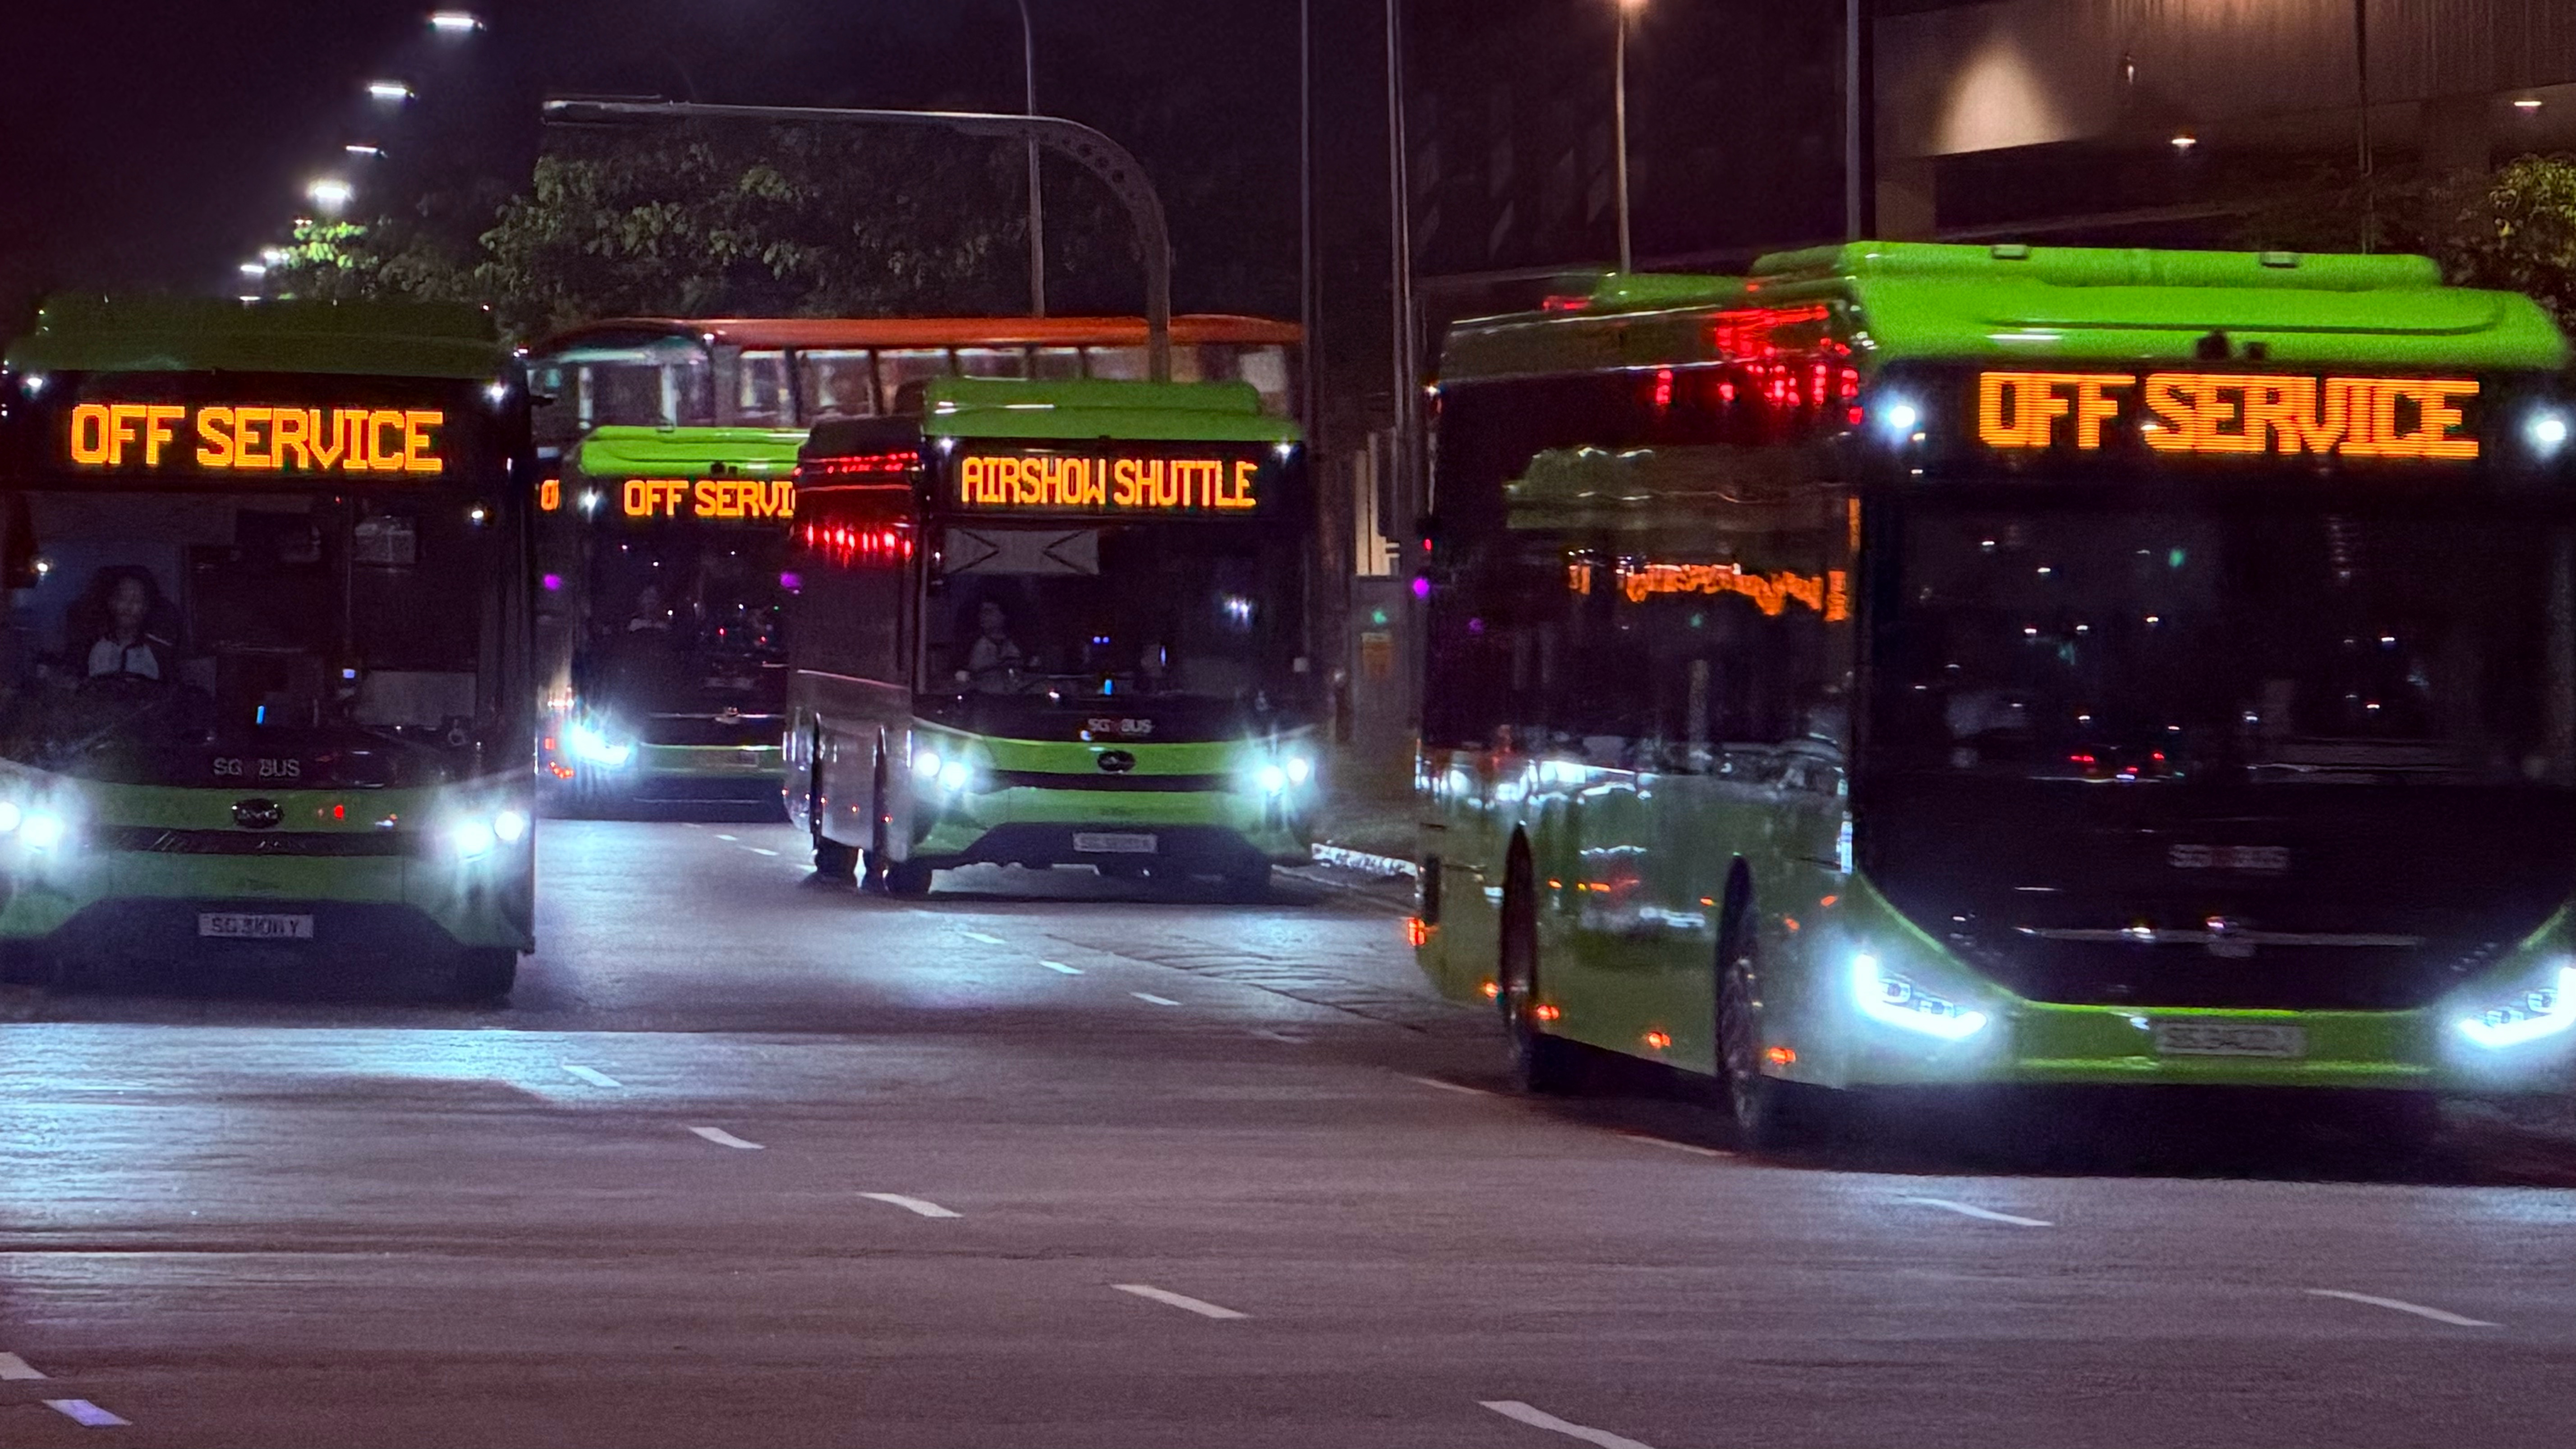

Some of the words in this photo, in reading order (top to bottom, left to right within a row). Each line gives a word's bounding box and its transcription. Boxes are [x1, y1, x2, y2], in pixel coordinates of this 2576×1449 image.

[70, 404, 185, 465] OFF
[197, 406, 443, 471] SERVICE
[1979, 372, 2136, 449] OFF
[2143, 373, 2479, 459] SERVICE
[624, 480, 689, 516] OFF
[961, 457, 1106, 505] AIRSHOW
[1113, 459, 1258, 507] SHUTTLE
[213, 757, 243, 776] SG
[259, 758, 301, 777] BUS
